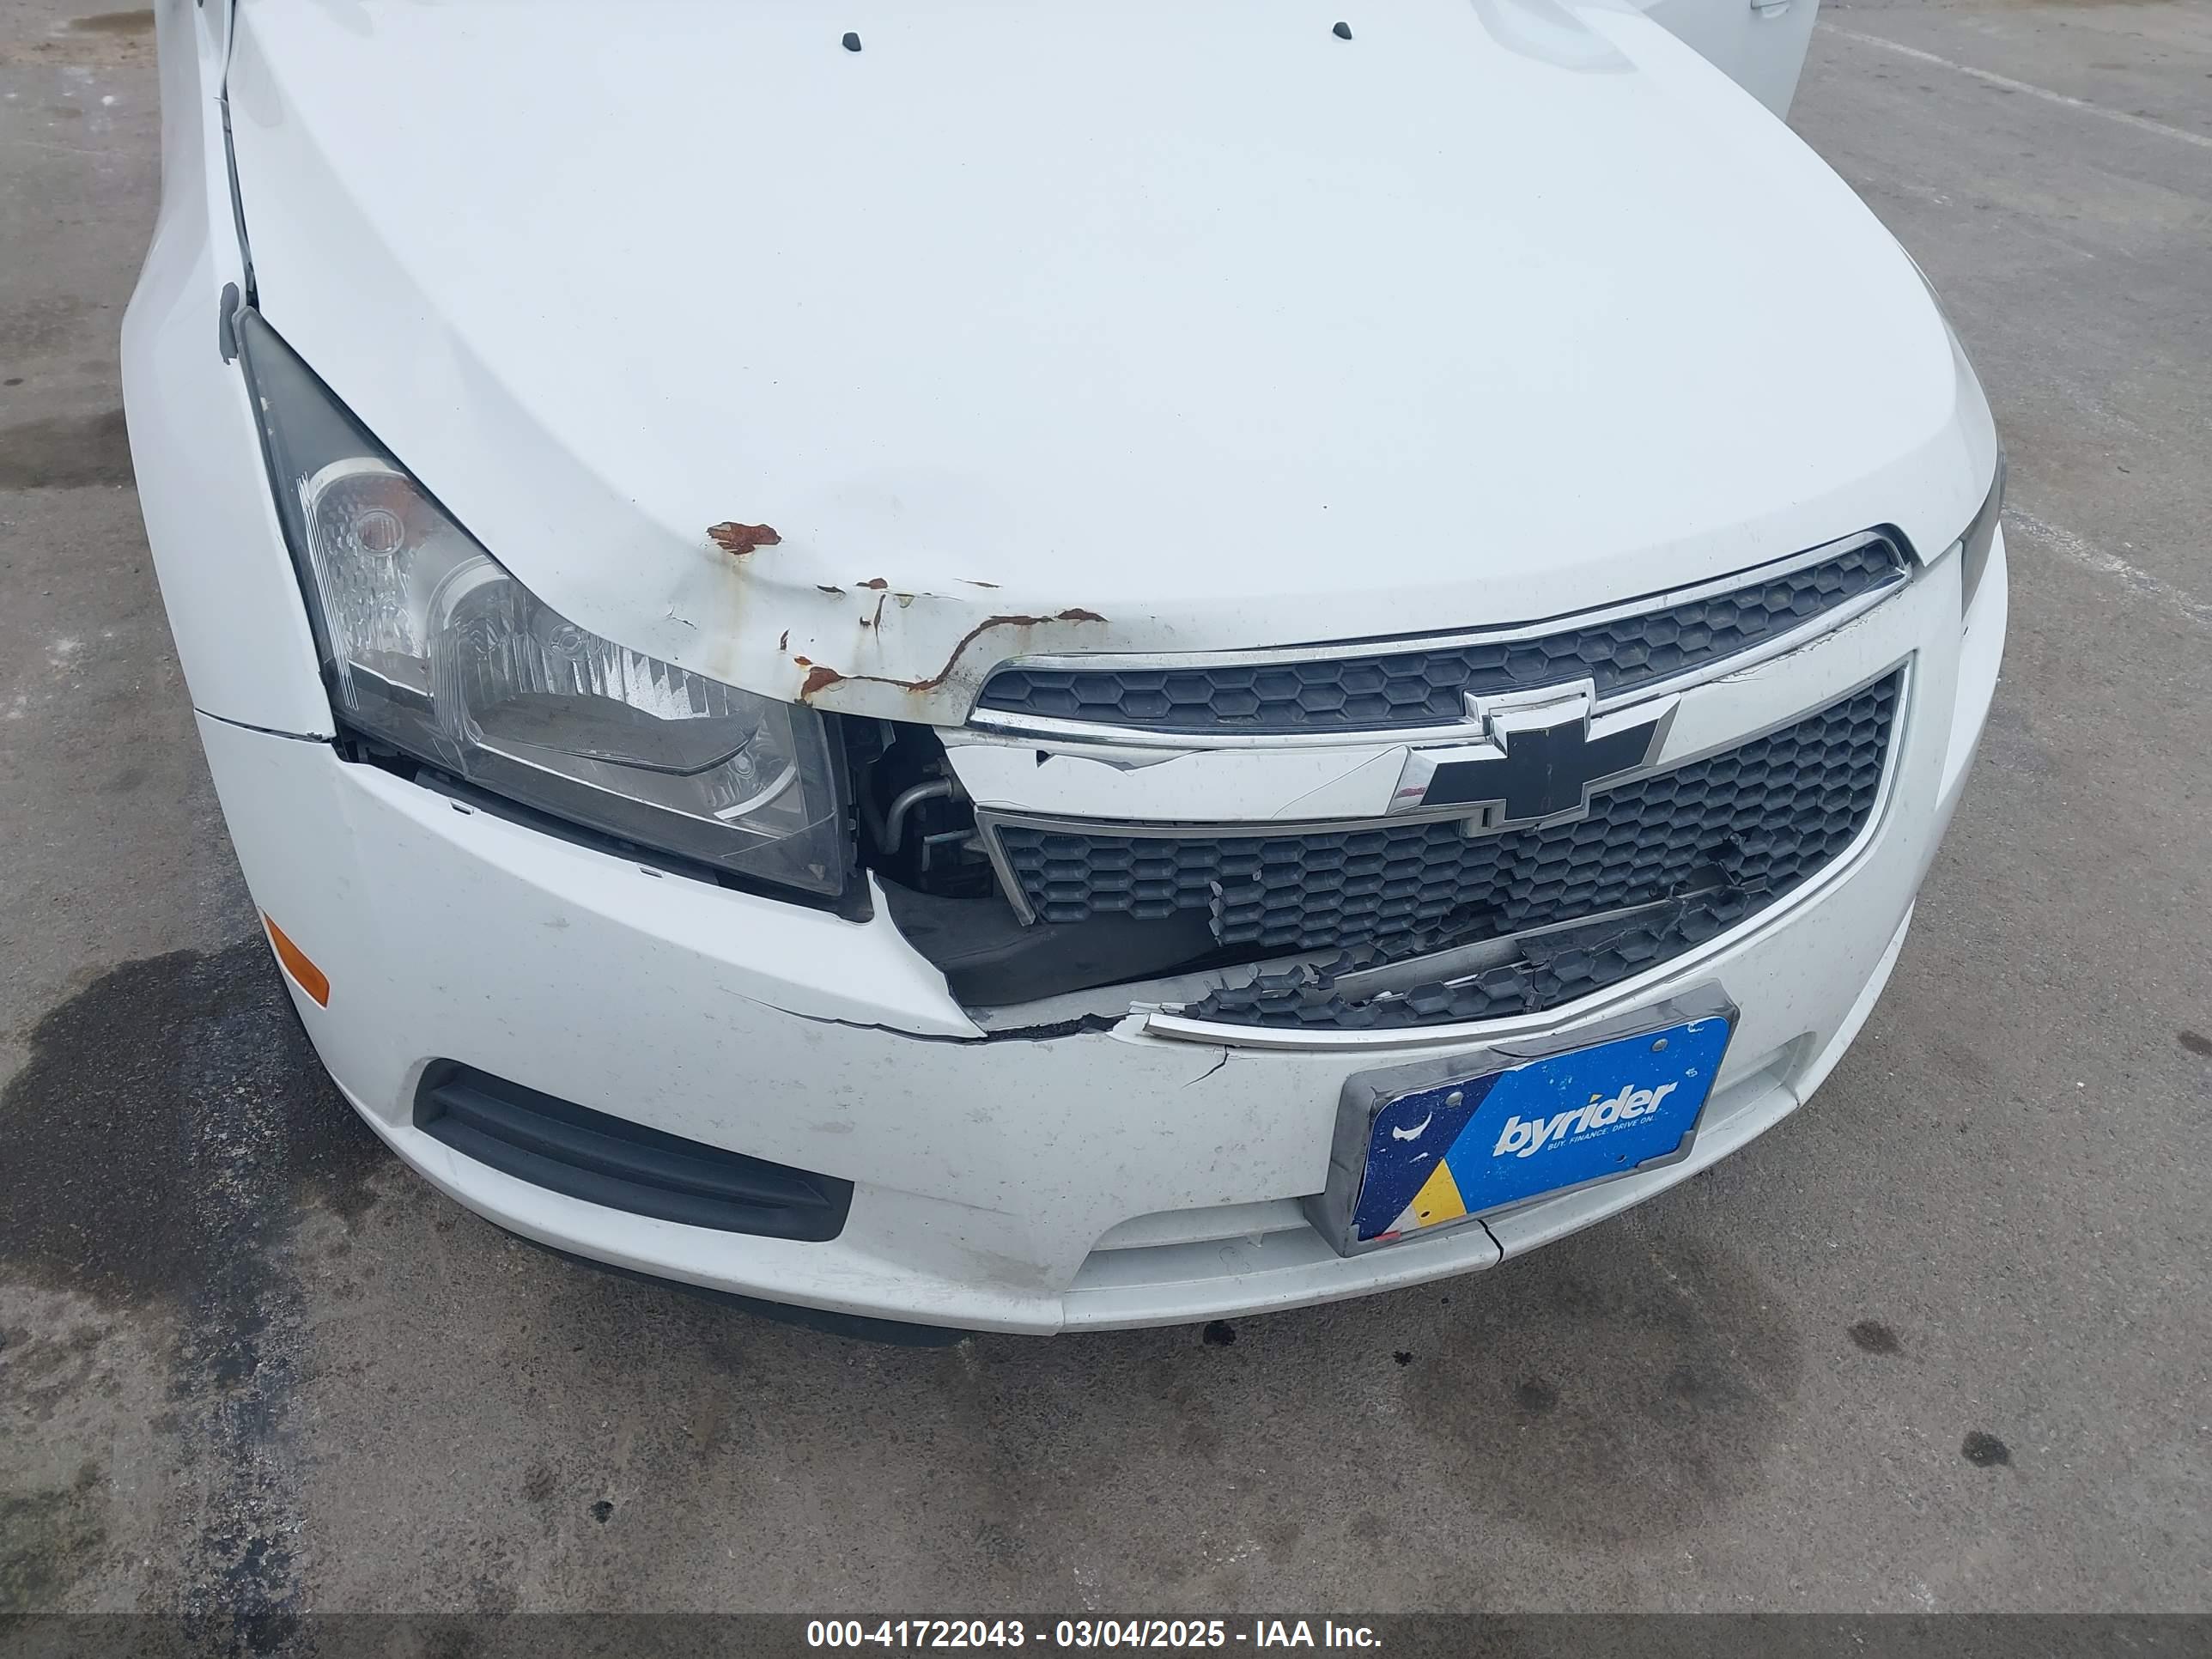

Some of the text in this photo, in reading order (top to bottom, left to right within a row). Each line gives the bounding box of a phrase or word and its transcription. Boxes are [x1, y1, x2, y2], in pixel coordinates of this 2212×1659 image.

[1492, 1081, 1678, 1158] byrider
[1547, 1139, 1566, 1151] BUY.
[1570, 1127, 1609, 1145] FINANCE.
[1612, 1119, 1639, 1132] DRIVE
